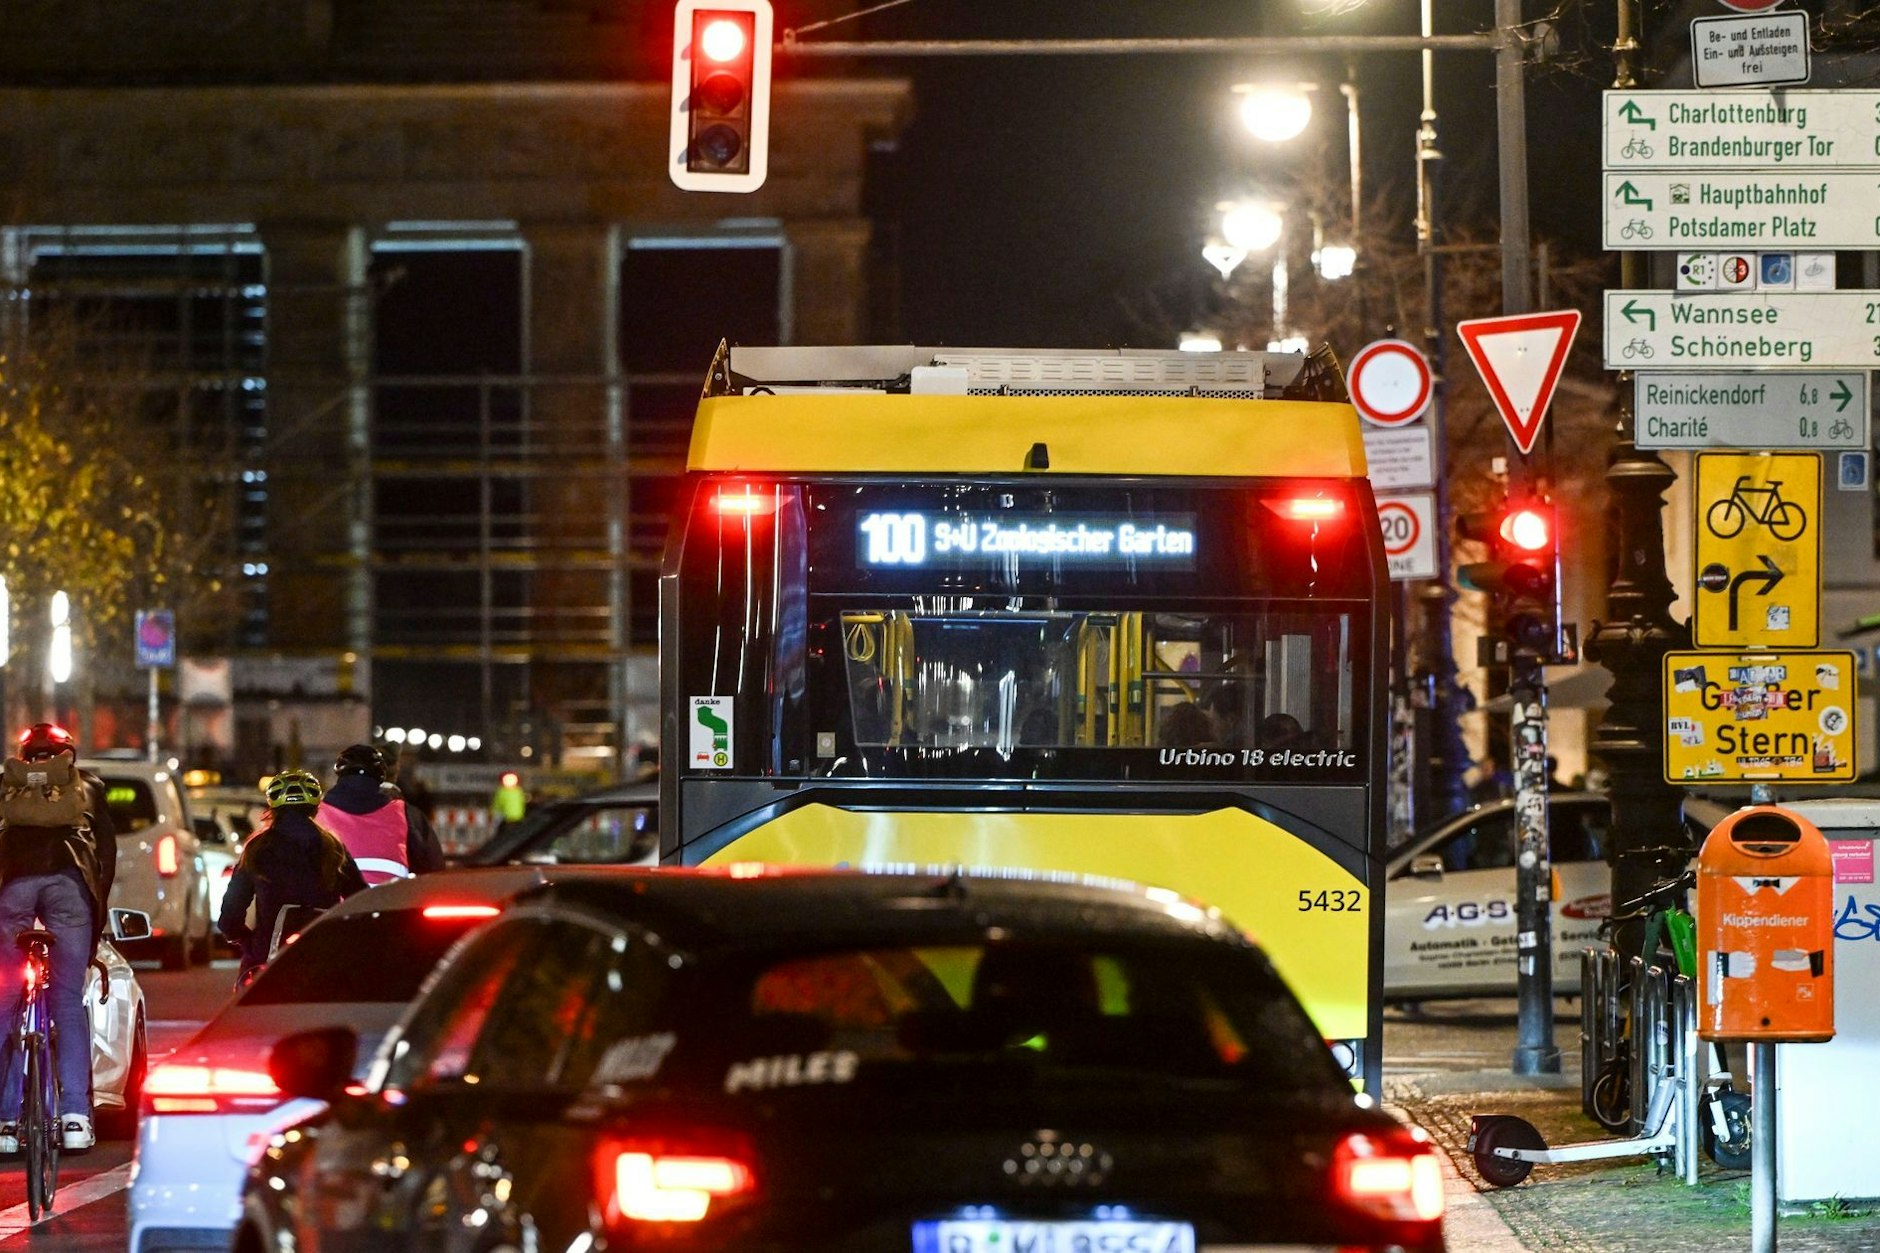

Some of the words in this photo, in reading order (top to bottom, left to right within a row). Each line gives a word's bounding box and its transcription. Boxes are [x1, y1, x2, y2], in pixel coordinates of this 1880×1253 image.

[1709, 30, 1726, 43] Be-
[1731, 28, 1747, 41] und
[1751, 26, 1791, 40] Entladen
[1703, 47, 1723, 60] Ein-
[1728, 45, 1744, 58] und
[1749, 44, 1798, 58] Aussteigen
[1742, 61, 1763, 74] frei
[1669, 102, 1807, 129] Charlottenburg
[1669, 135, 1802, 162] Brandenburger
[1807, 135, 1834, 157] Tor
[1700, 183, 1827, 210] Hauptbahnhof
[1669, 216, 1766, 238] Potsdamer
[1772, 216, 1817, 238] Platz
[1692, 264, 1705, 275] R1
[1671, 302, 1778, 324] Wannsee
[1671, 335, 1812, 362] Schöneberg
[1647, 383, 1766, 405] Reinickendorf
[1647, 416, 1708, 438] Charité
[861, 512, 925, 563] 100
[935, 523, 977, 552] S+U
[982, 523, 1114, 553] Zoologischer
[1119, 524, 1193, 553] Garten
[1381, 516, 1409, 541] 20
[1716, 724, 1808, 755] Stern
[1159, 748, 1235, 766] Urbino
[1241, 749, 1265, 767] 18
[1269, 749, 1357, 767] electric
[1298, 890, 1361, 912] 5432
[1723, 913, 1809, 929] Kippendiener
[1410, 938, 1478, 951] Automatik
